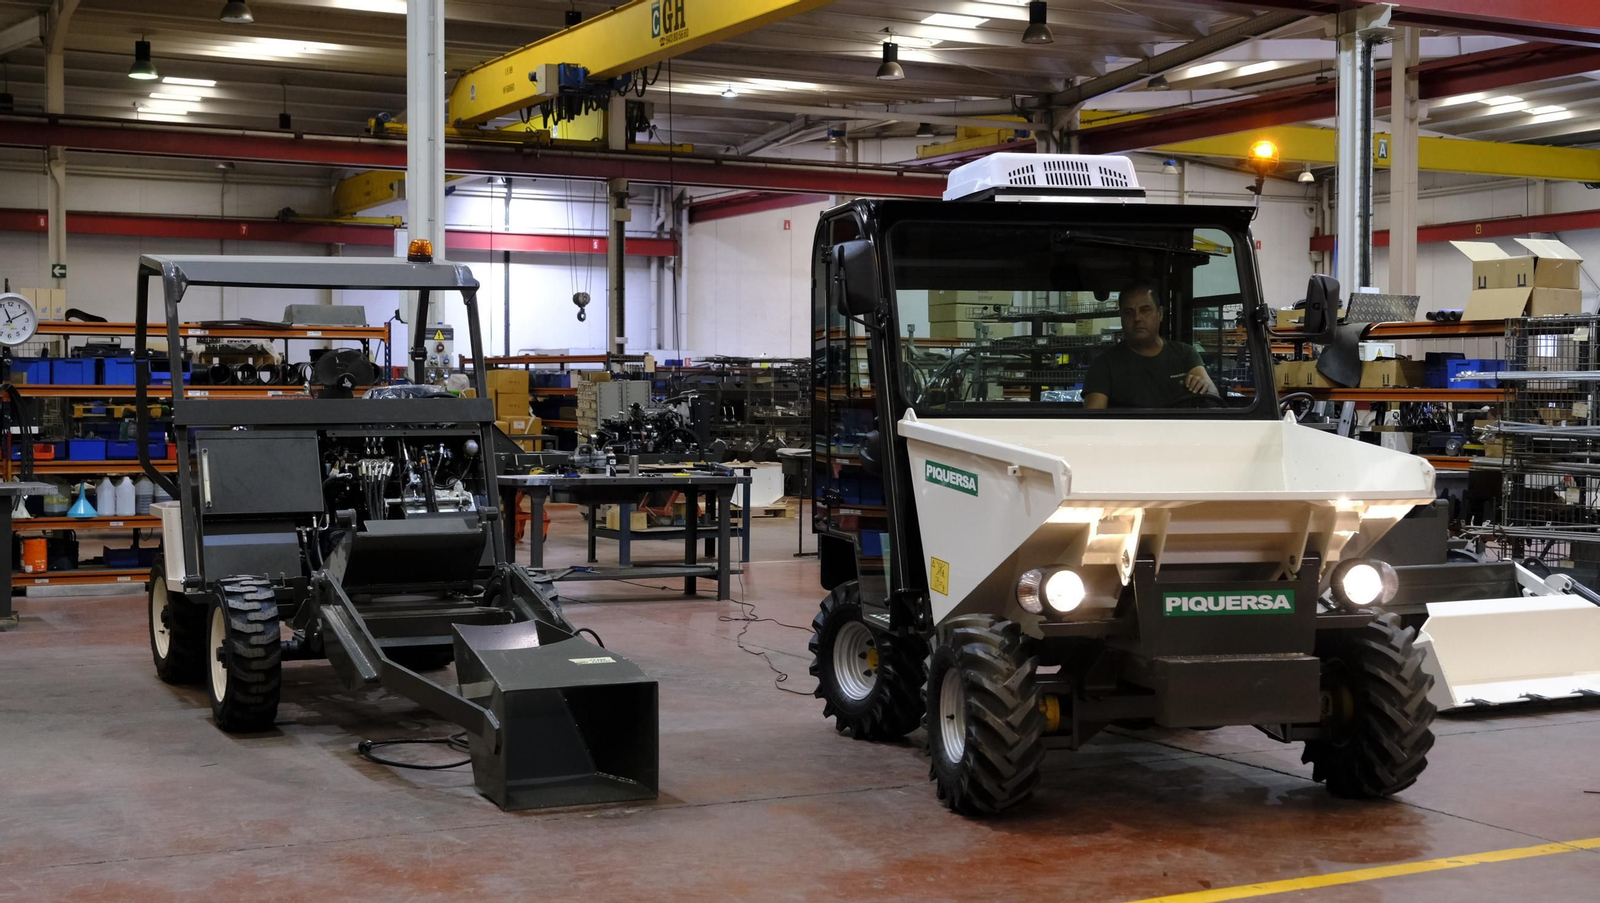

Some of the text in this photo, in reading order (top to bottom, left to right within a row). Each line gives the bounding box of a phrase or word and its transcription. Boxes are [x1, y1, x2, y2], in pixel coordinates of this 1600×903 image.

[653, 10, 660, 35] C
[663, 0, 686, 34] GH
[1379, 143, 1387, 158] A
[40, 218, 45, 227] 8
[242, 226, 247, 234] 7
[593, 241, 598, 249] 5
[926, 464, 977, 491] PIQUERSA
[1166, 595, 1292, 612] PIQUERSA
